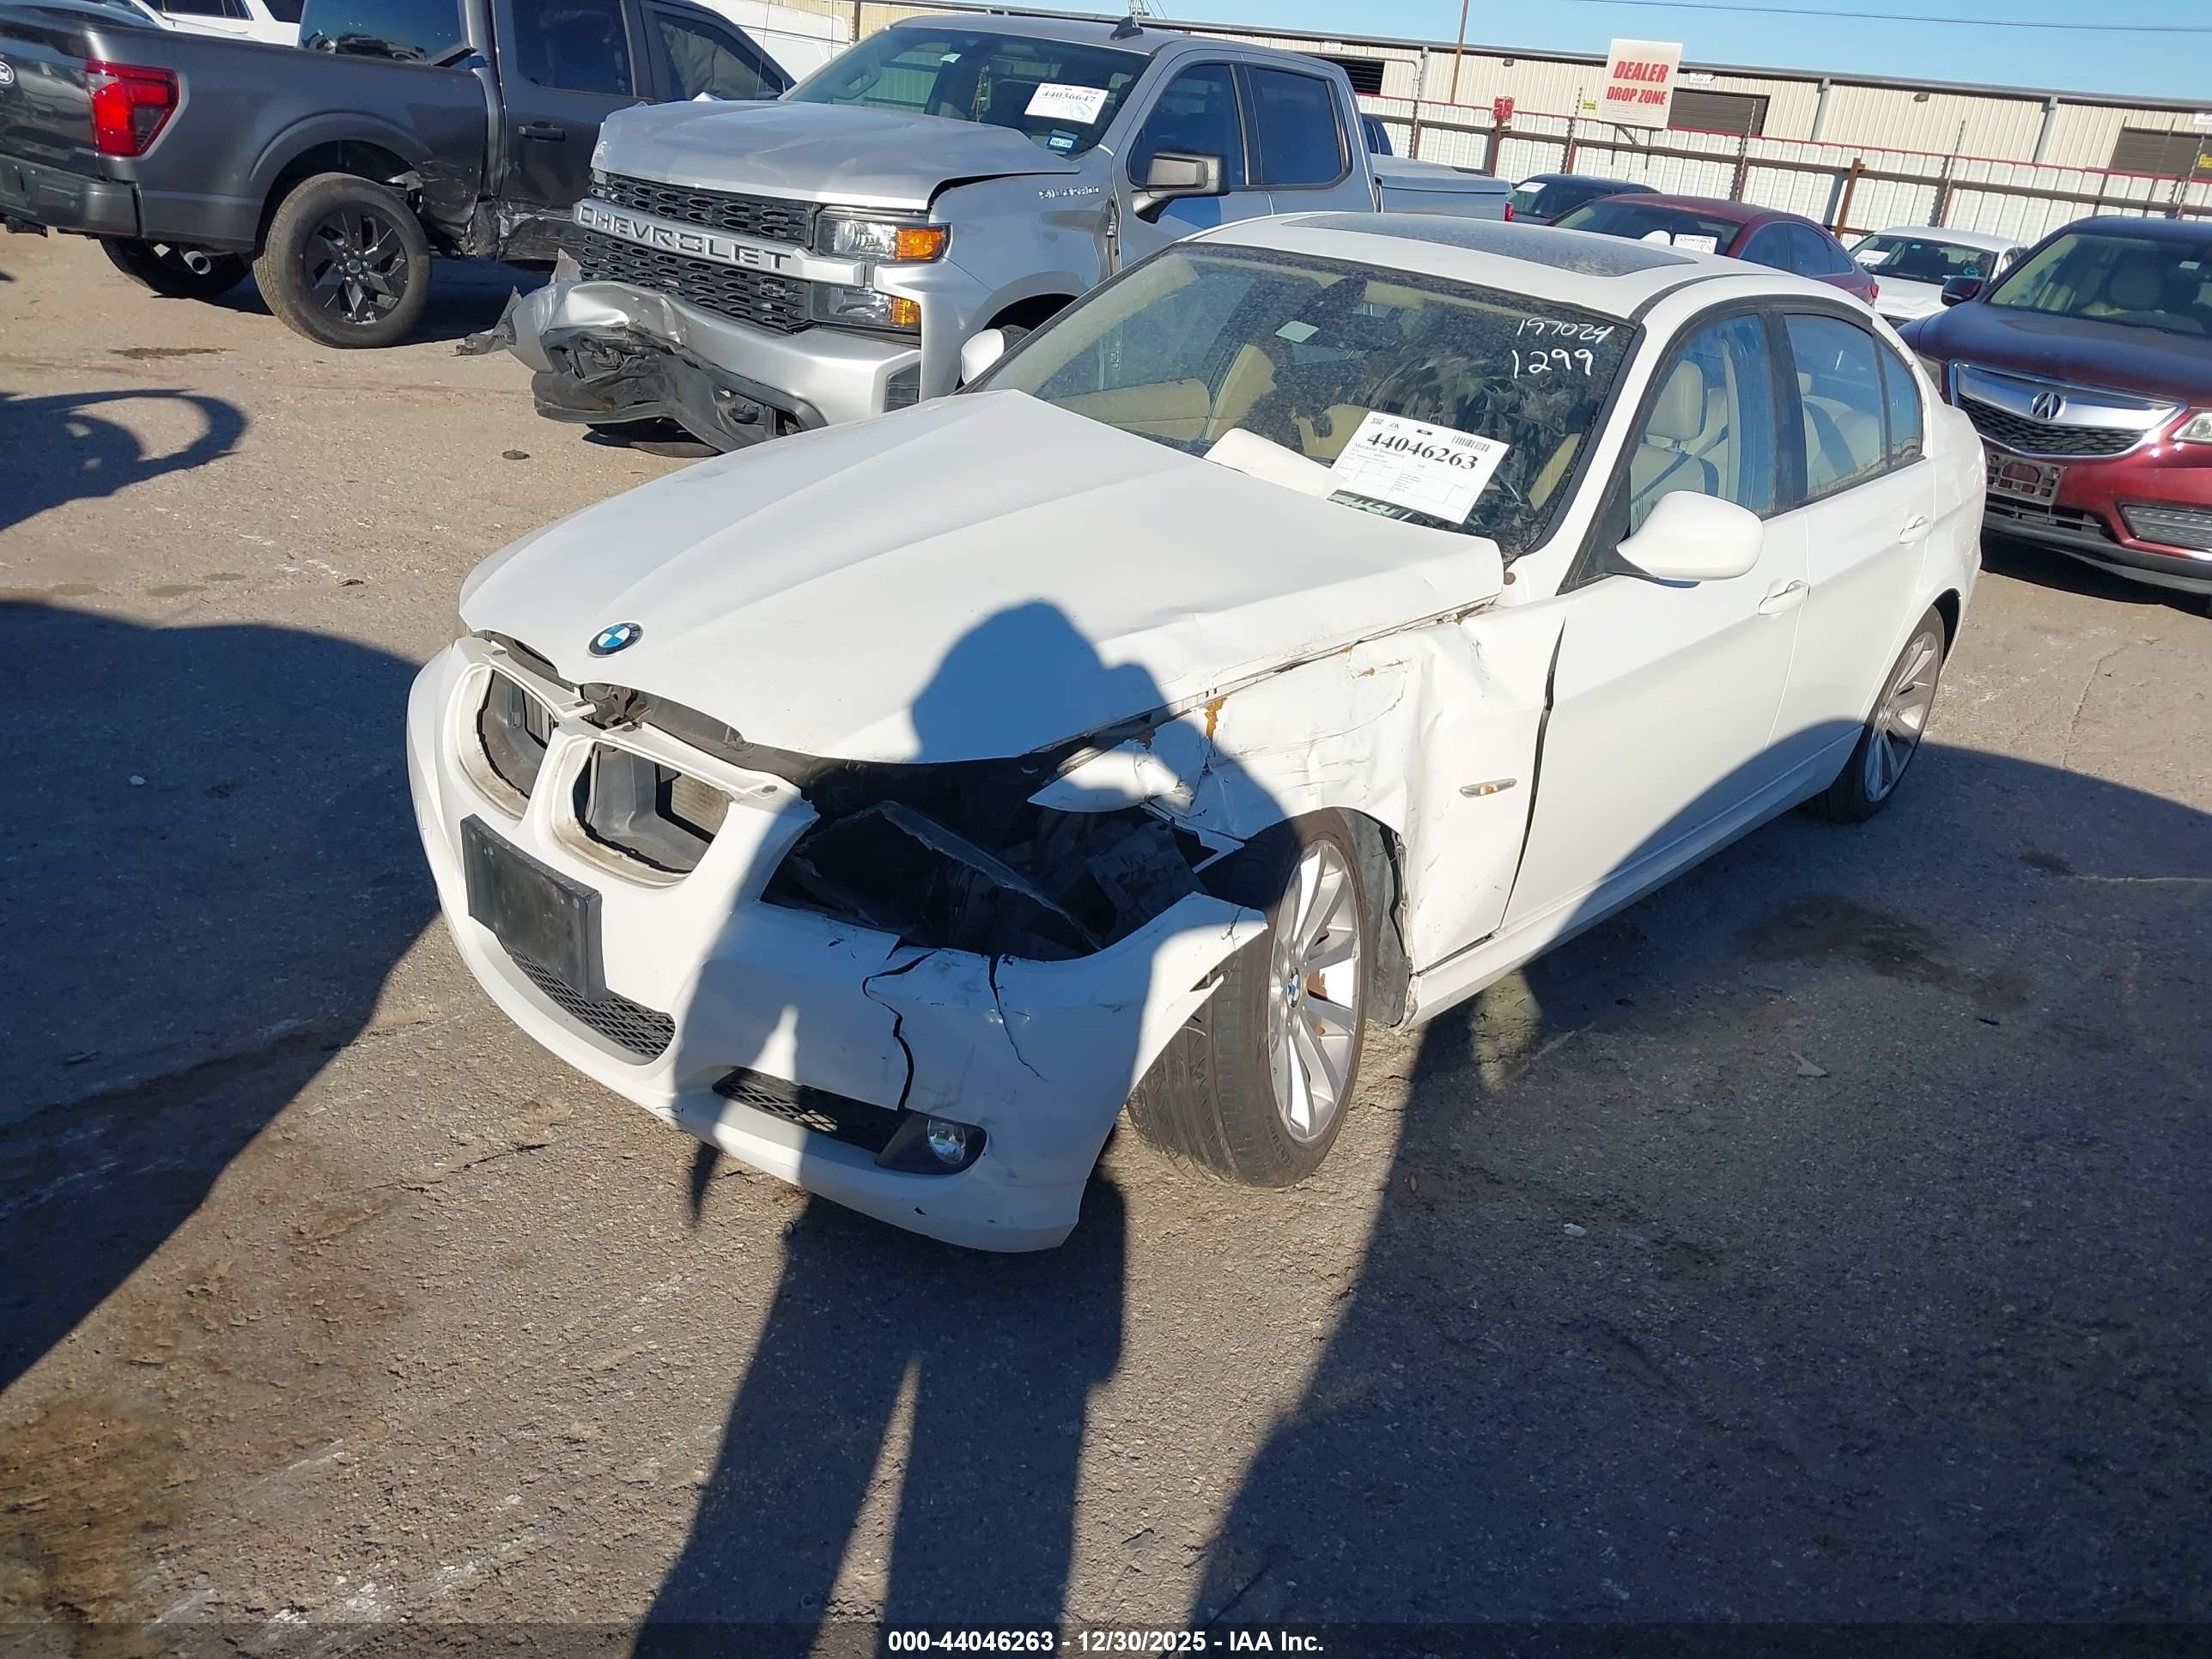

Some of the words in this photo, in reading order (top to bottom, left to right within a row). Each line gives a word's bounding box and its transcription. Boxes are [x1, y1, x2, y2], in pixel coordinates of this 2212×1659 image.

[1613, 60, 1669, 83] DEALER
[1606, 86, 1638, 102] DROP
[1638, 88, 1668, 105] ZONE
[578, 204, 792, 270] CHEVROLET
[1511, 348, 1594, 380] 1299
[1367, 432, 1479, 470] 44046263
